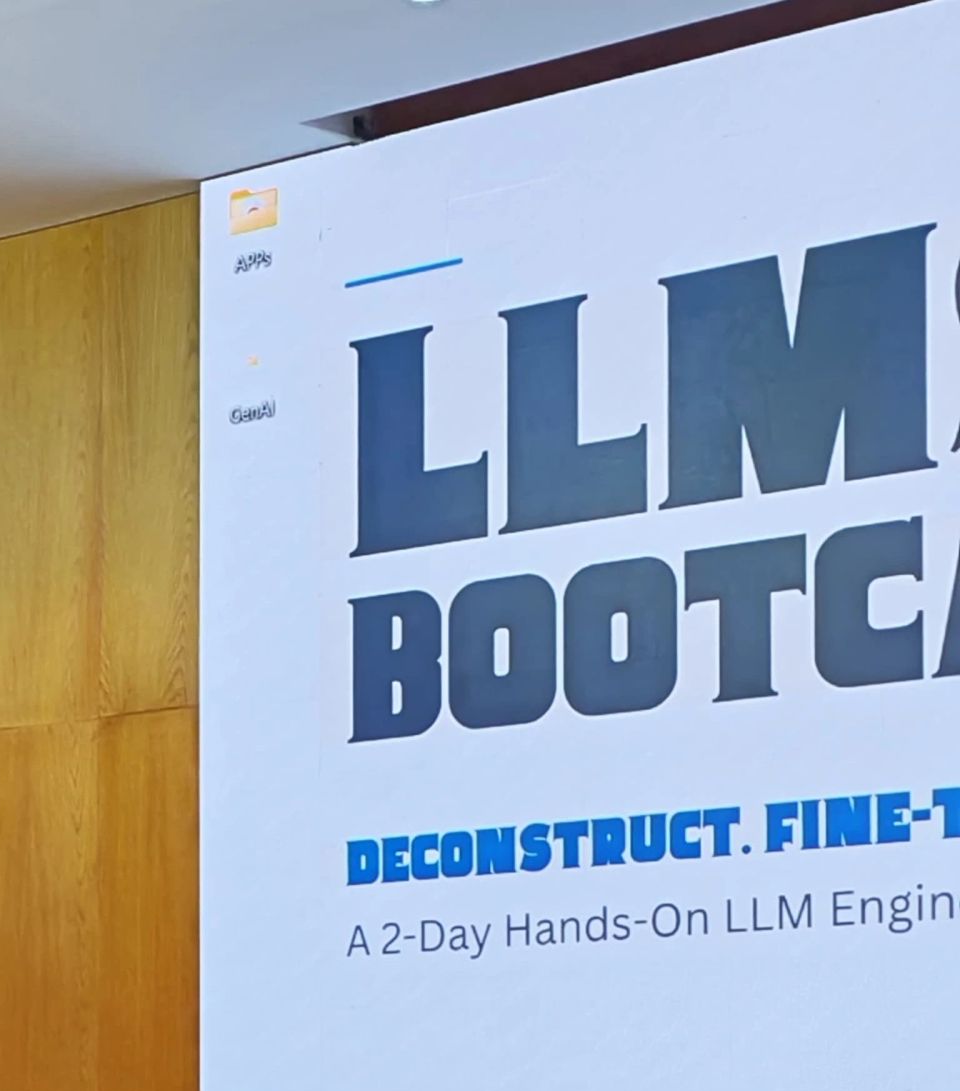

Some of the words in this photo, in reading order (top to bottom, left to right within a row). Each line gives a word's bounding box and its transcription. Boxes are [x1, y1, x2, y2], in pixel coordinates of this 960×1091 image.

[229, 399, 276, 426] GenAI
[348, 222, 960, 559] LLM
[346, 806, 753, 886] DECONSTRUCT.
[346, 924, 371, 957] A
[381, 919, 492, 960] 2-Day
[506, 902, 709, 948] Hands-On
[726, 893, 813, 933] LLM
[832, 883, 960, 935] Engin
